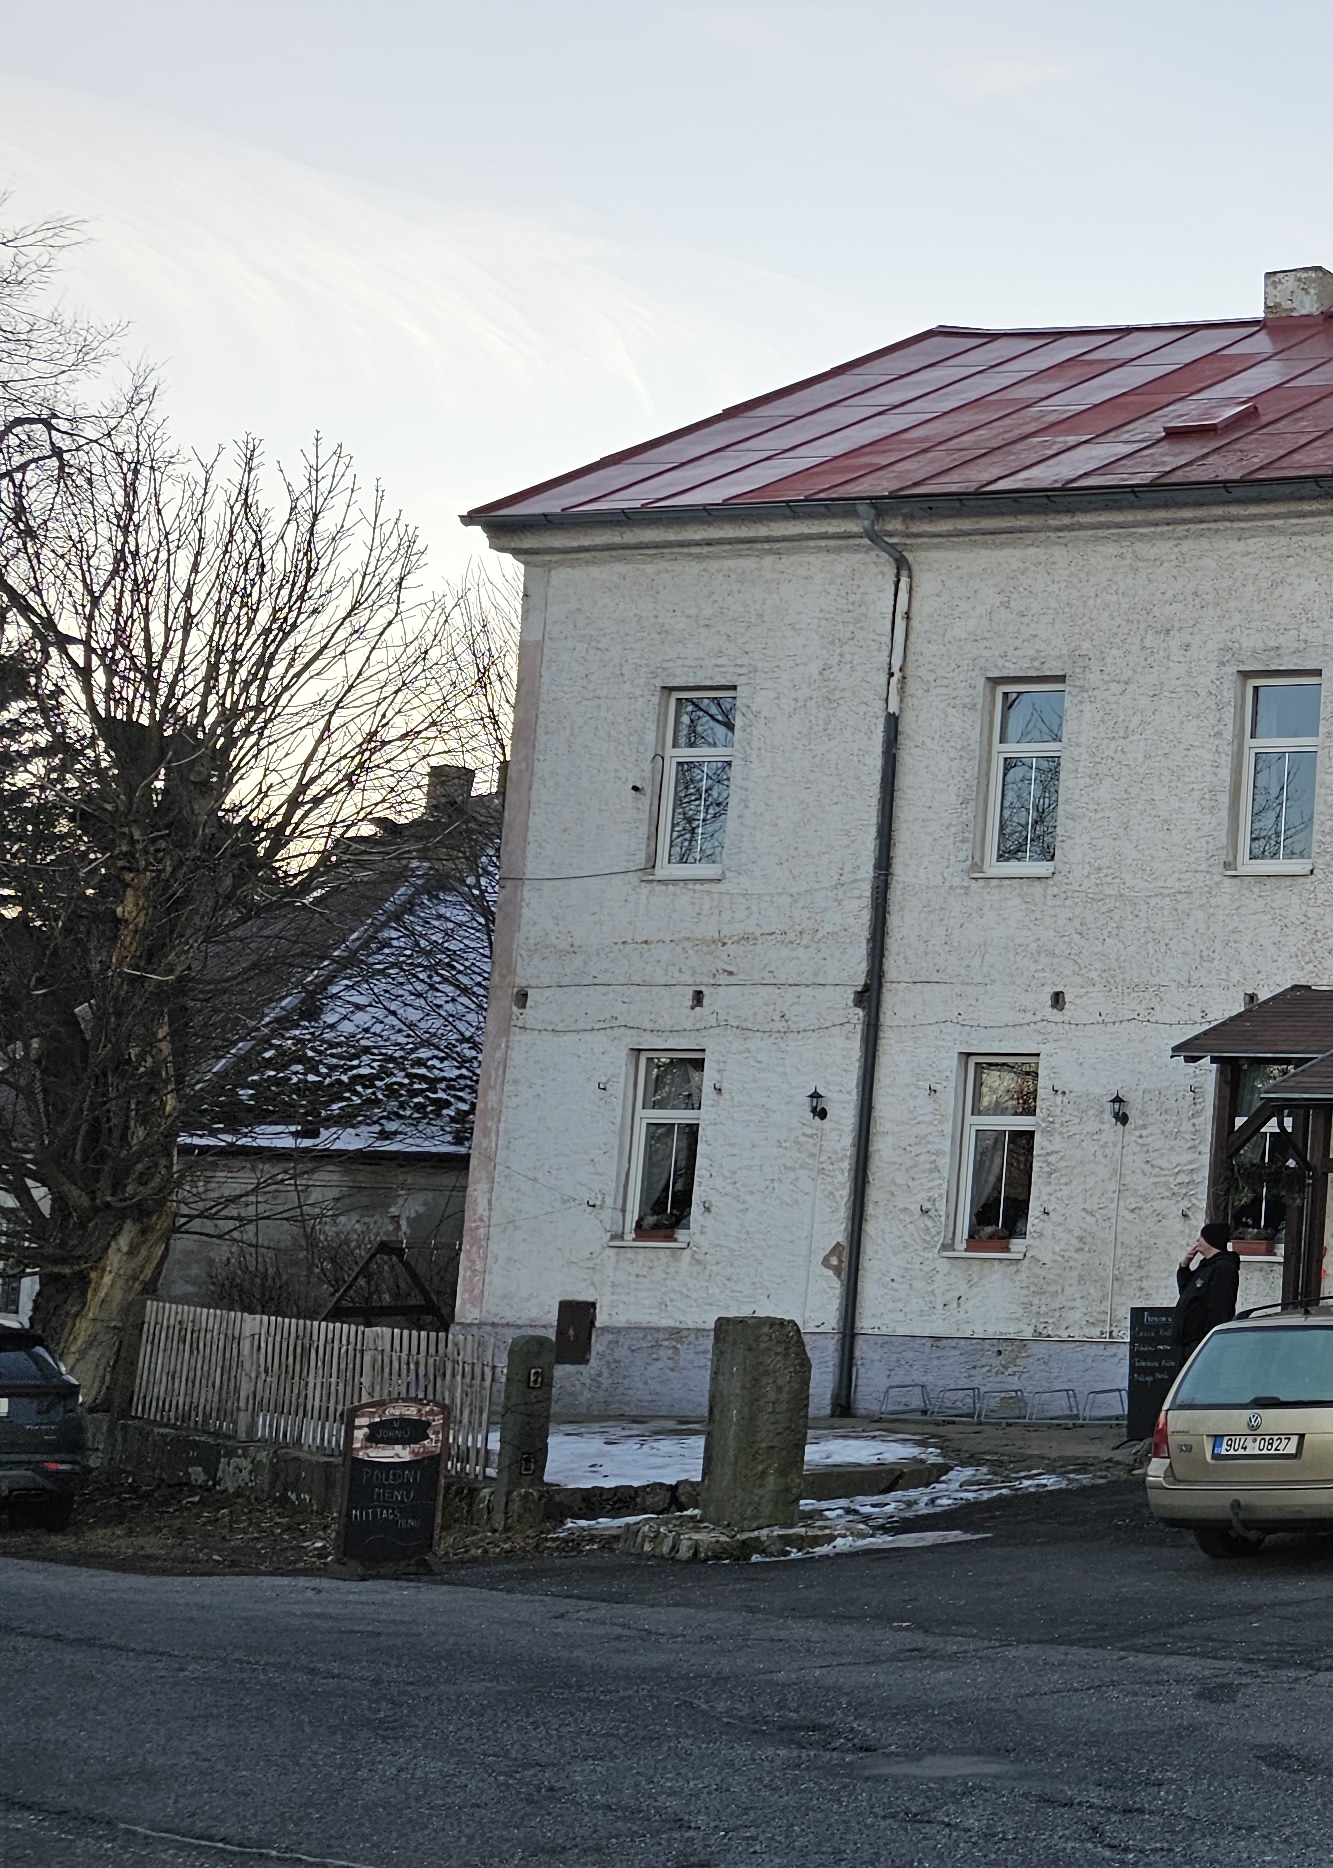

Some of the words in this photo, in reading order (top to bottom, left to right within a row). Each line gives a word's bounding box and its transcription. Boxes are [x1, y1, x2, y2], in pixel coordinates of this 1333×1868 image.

[1224, 1437, 1248, 1452] 9U4
[1258, 1437, 1292, 1452] 0827
[352, 1508, 400, 1521] MITTAGS
